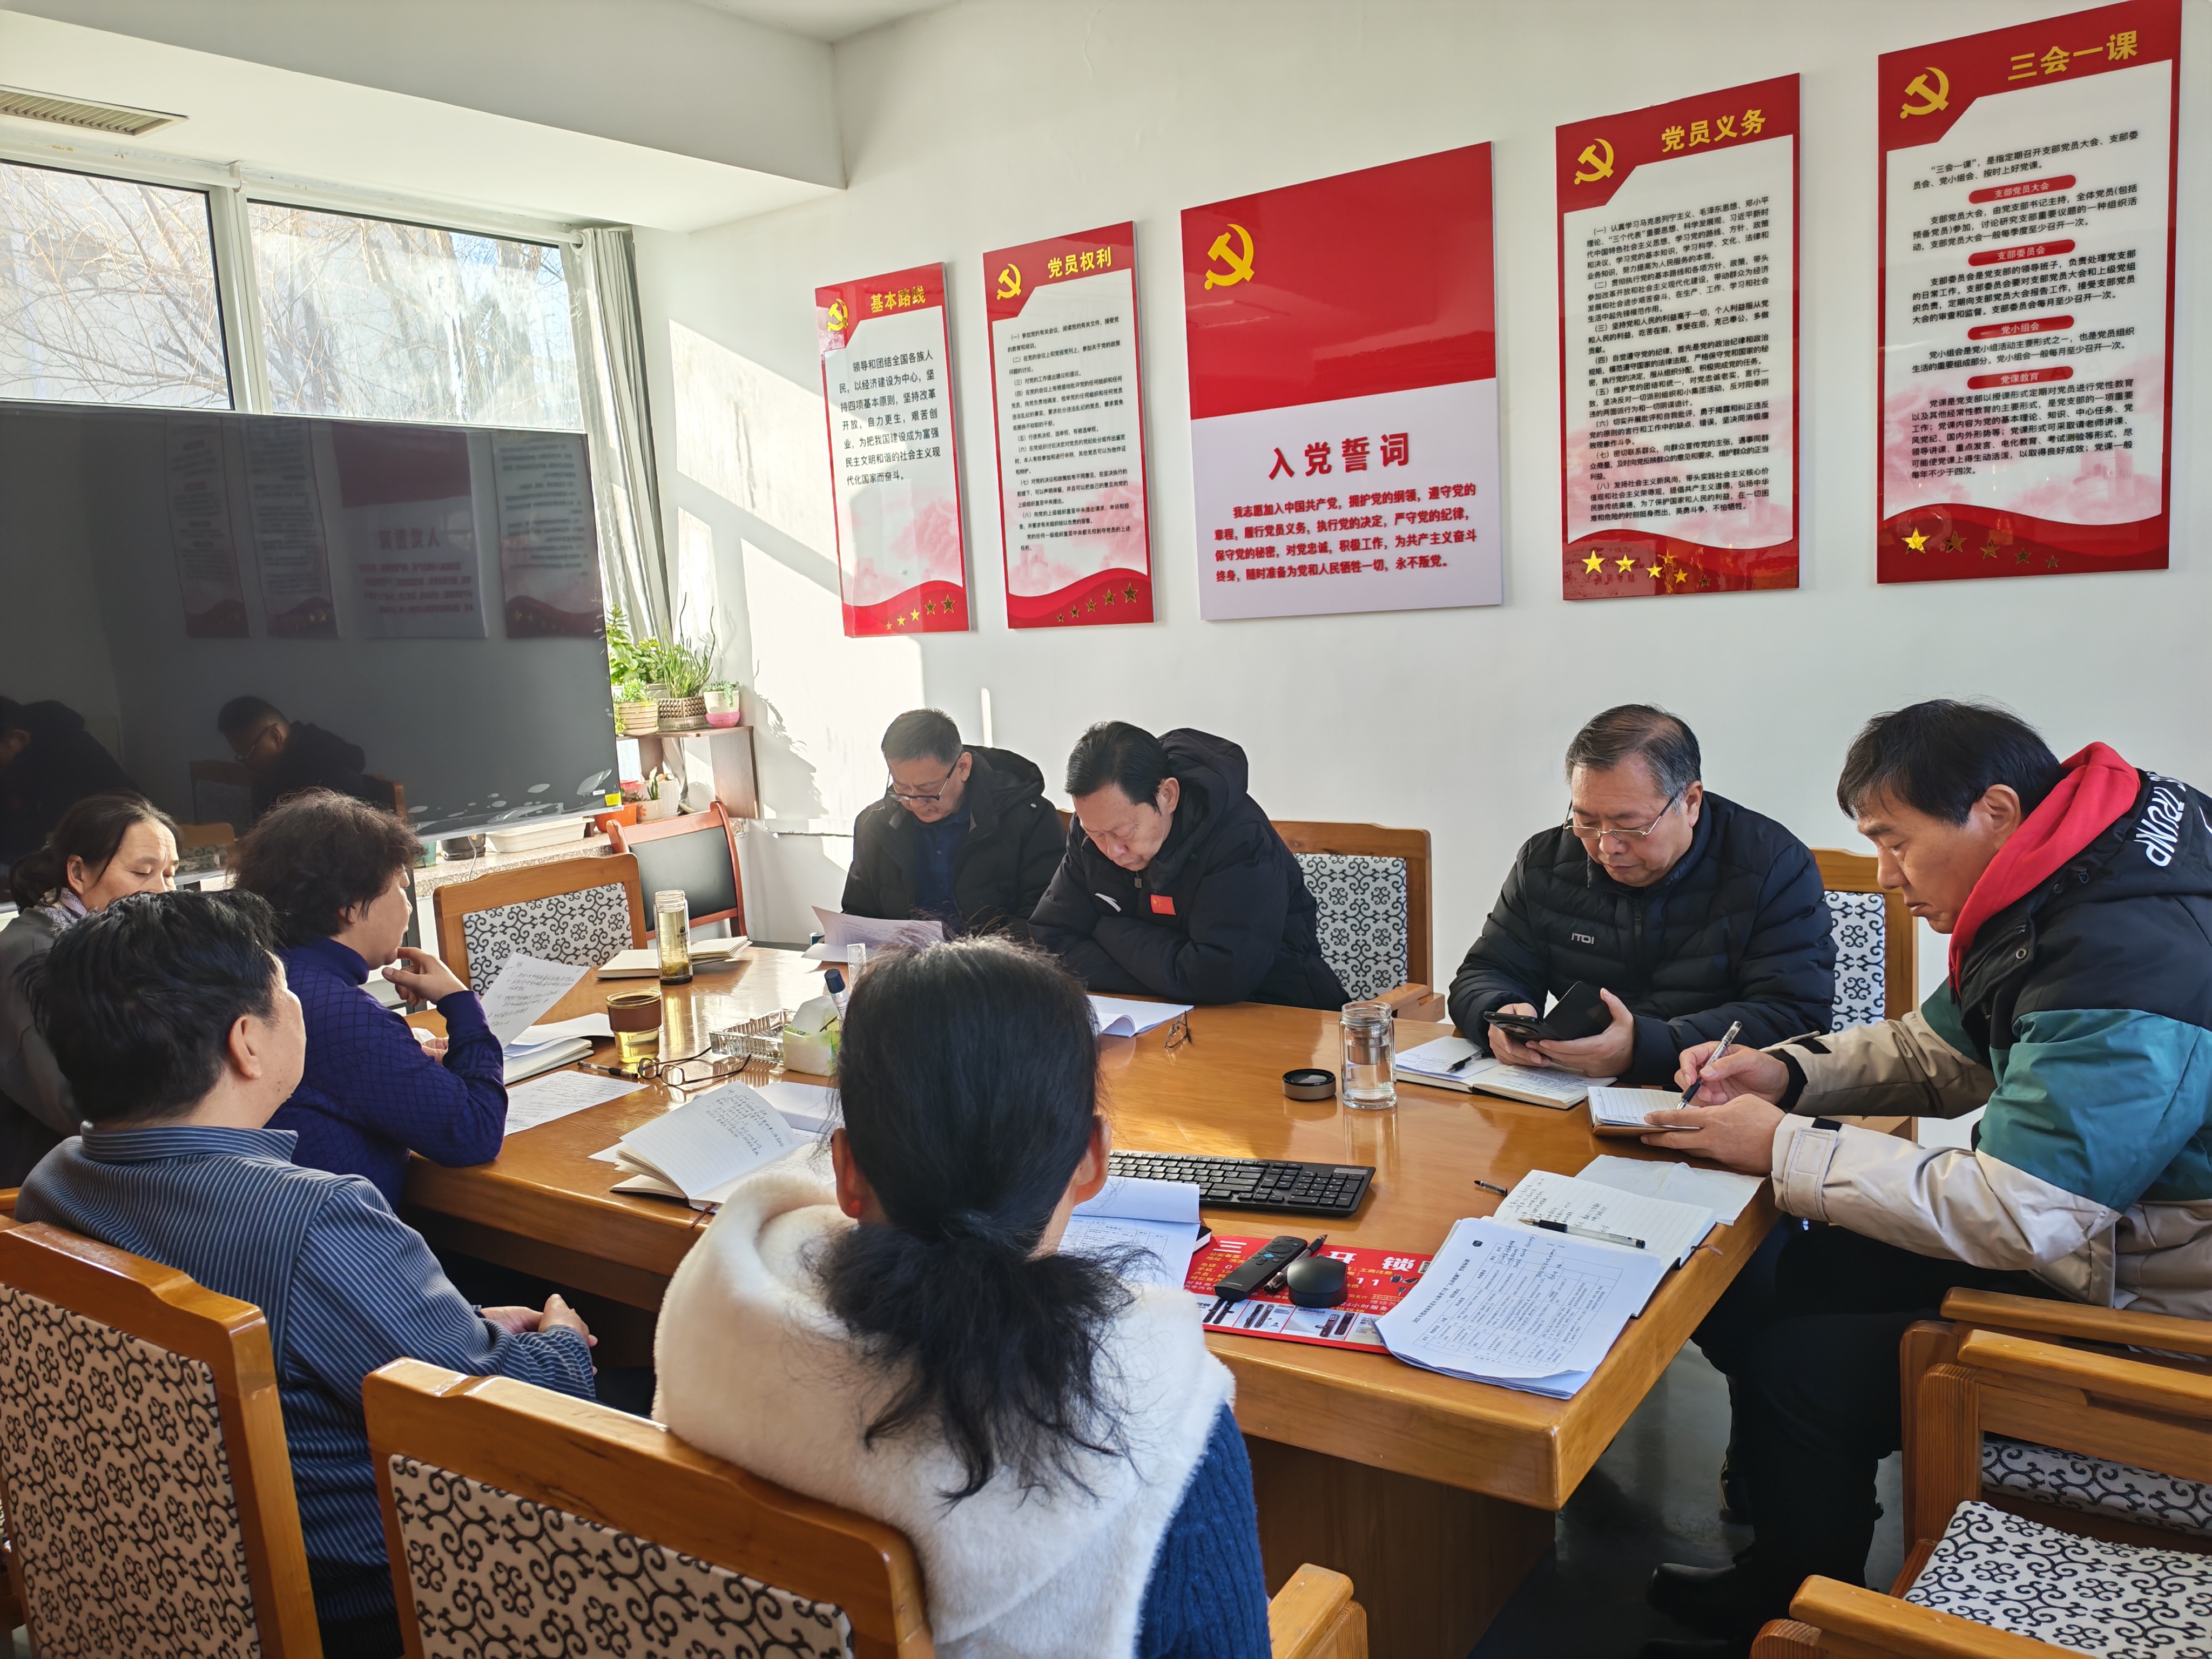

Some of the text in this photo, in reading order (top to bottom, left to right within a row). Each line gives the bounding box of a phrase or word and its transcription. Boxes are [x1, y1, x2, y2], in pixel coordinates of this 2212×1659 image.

[2008, 30, 2137, 80] 三会一课
[1662, 110, 1765, 152] 党员义务
[1994, 181, 2049, 198] 支部党员大会
[1996, 245, 2046, 260] 支部委员会
[1048, 246, 1111, 278] 党员权利
[871, 286, 926, 313] 基本路线
[1588, 305, 1662, 323] 生活中起先锋模范作用。
[2000, 321, 2040, 335] 党小组会
[1588, 346, 1605, 355] 贡献。
[1999, 372, 2039, 385] 党课教育
[1589, 439, 1635, 449] 败现象作斗争。
[1269, 433, 1409, 480] 入党誓词
[845, 470, 904, 487] 代化国家而奋斗。
[1590, 473, 1606, 481] 利益。
[1911, 467, 1975, 479] 每年不少于四次。
[1382, 1257, 1415, 1272] 锁
